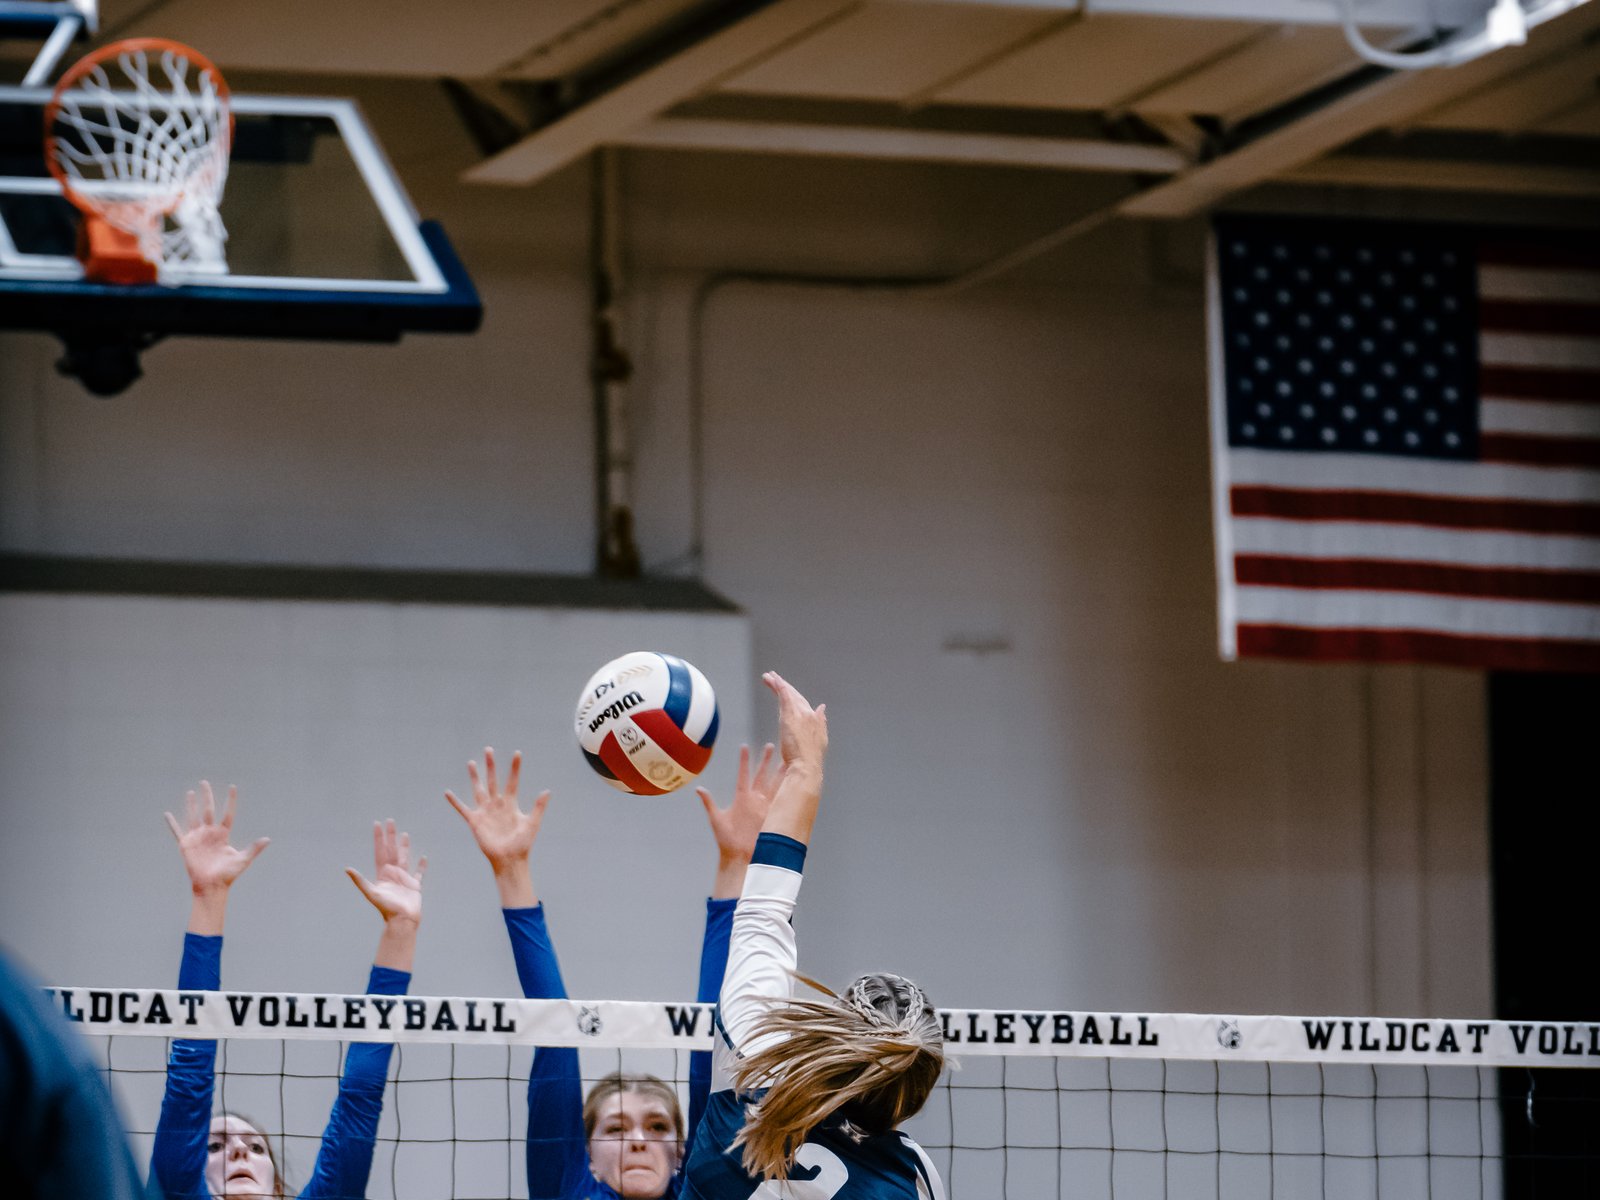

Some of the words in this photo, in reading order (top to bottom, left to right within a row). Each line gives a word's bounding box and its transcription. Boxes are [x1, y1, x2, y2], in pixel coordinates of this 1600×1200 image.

[589, 691, 645, 733] Wilson
[46, 989, 204, 1025] LDCAT
[226, 994, 516, 1033] VOLLEYBALL
[941, 1012, 1158, 1046] LLEYBALL
[1302, 1021, 1490, 1053] WILDCAT
